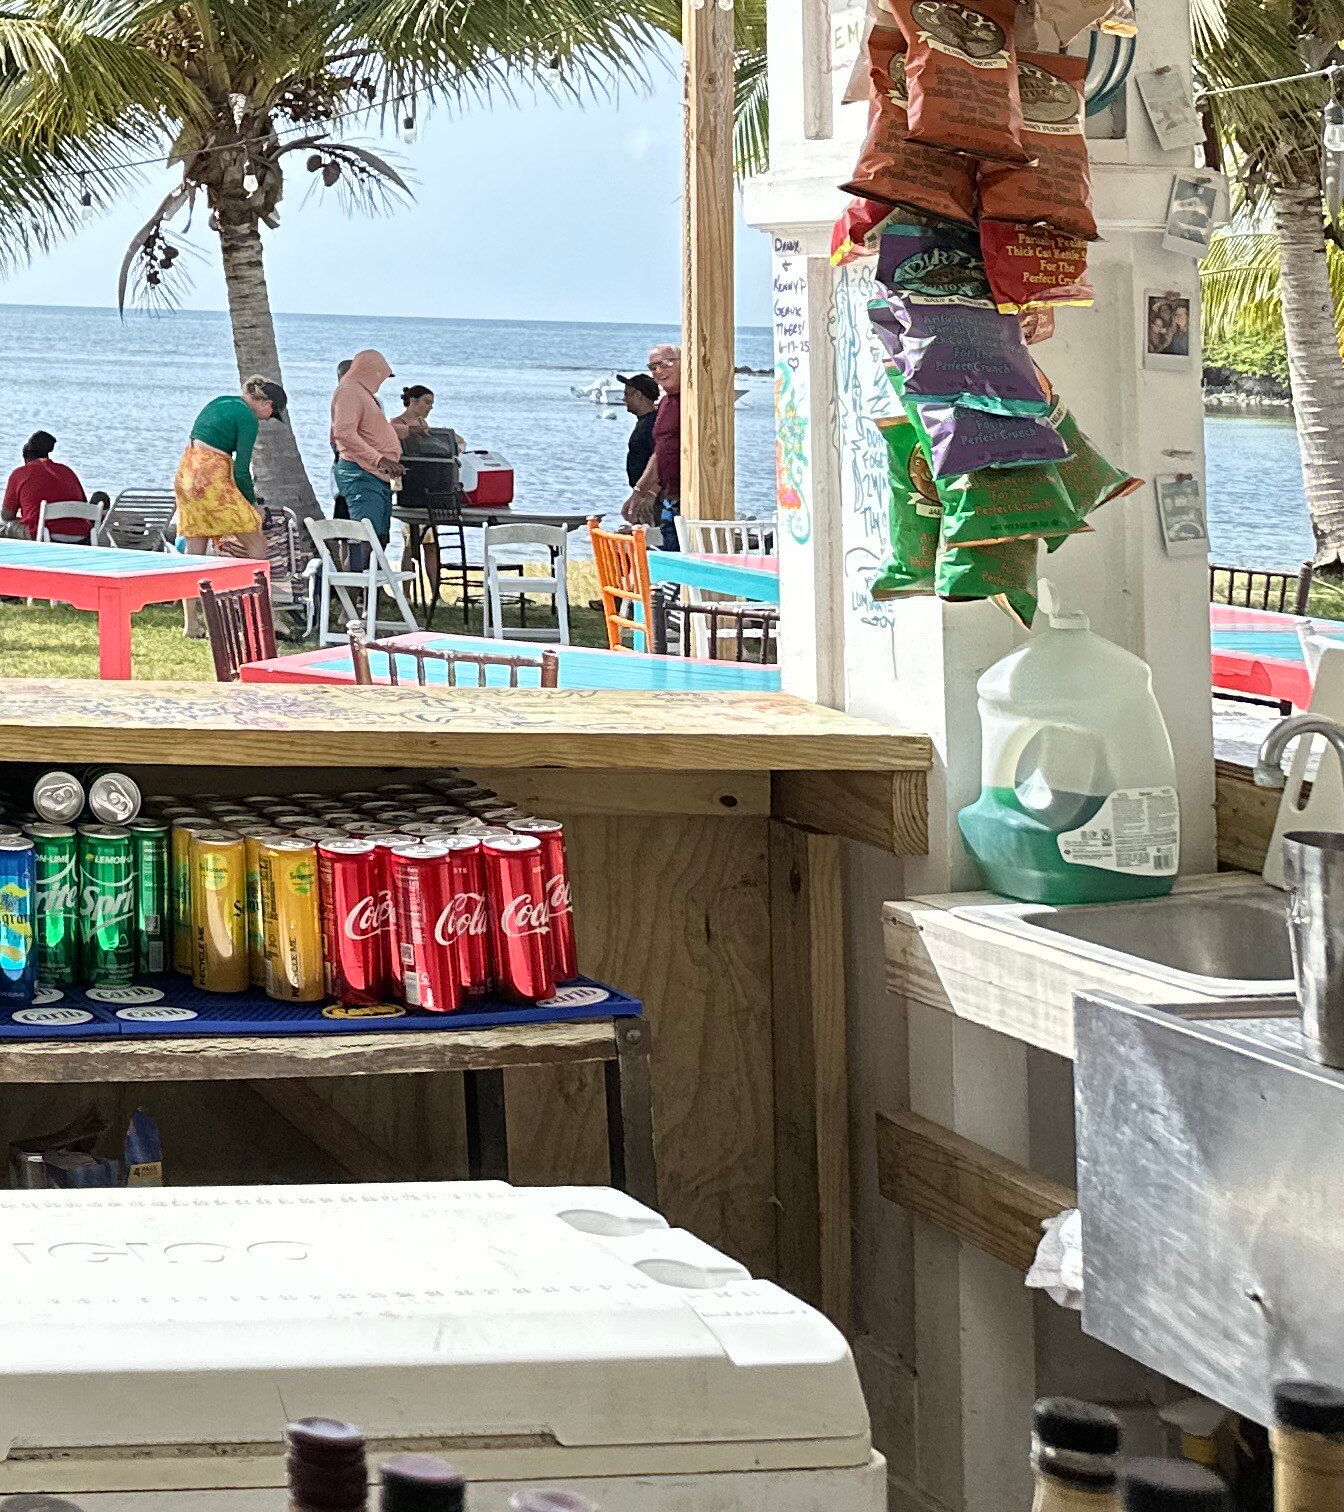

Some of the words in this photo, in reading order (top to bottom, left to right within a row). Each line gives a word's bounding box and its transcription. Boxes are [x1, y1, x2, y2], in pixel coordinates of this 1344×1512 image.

[1039, 260, 1056, 271] For
[1058, 261, 1075, 272] The
[95, 987, 154, 999] Carib
[22, 1009, 84, 1022] Carib
[127, 1008, 187, 1019] Carib
